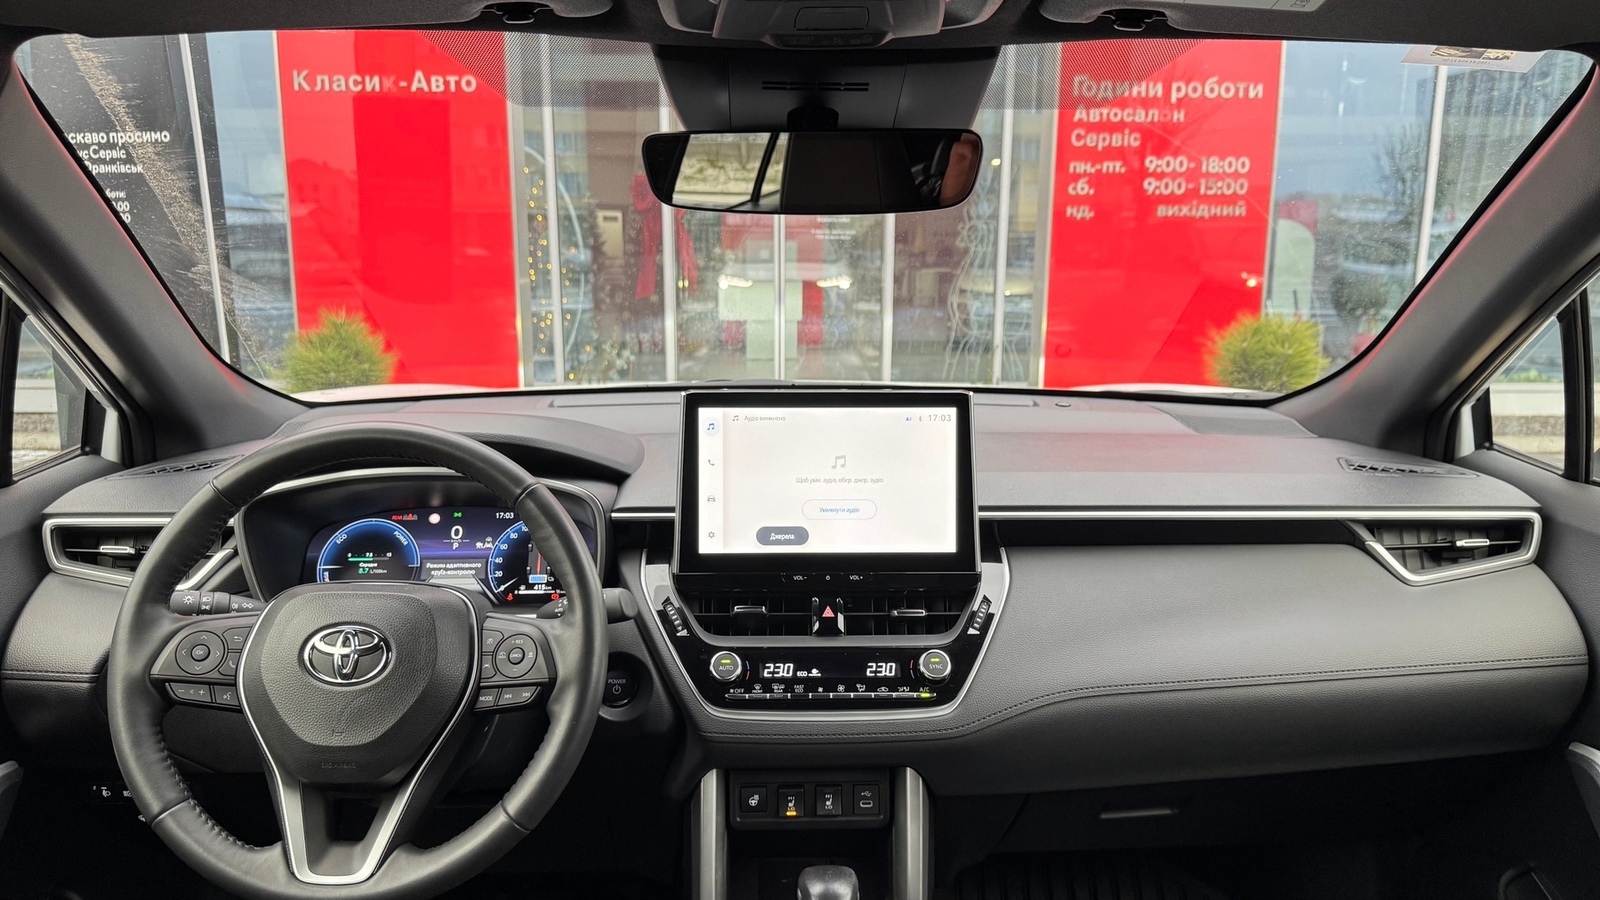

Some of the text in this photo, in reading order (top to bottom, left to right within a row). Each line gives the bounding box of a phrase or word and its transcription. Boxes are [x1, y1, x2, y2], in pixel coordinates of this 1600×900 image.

[292, 70, 477, 93] Класик-Авто
[1072, 74, 1264, 104] Години роботи
[1073, 106, 1185, 123] Автосалон
[66, 131, 171, 147] скаво просимо
[1070, 129, 1142, 151] Сервіс
[1067, 178, 1095, 195] сб.
[1066, 200, 1247, 219] нд. вихідний
[928, 414, 952, 422] 17:03
[335, 533, 348, 545] ECO
[450, 525, 463, 540] 0
